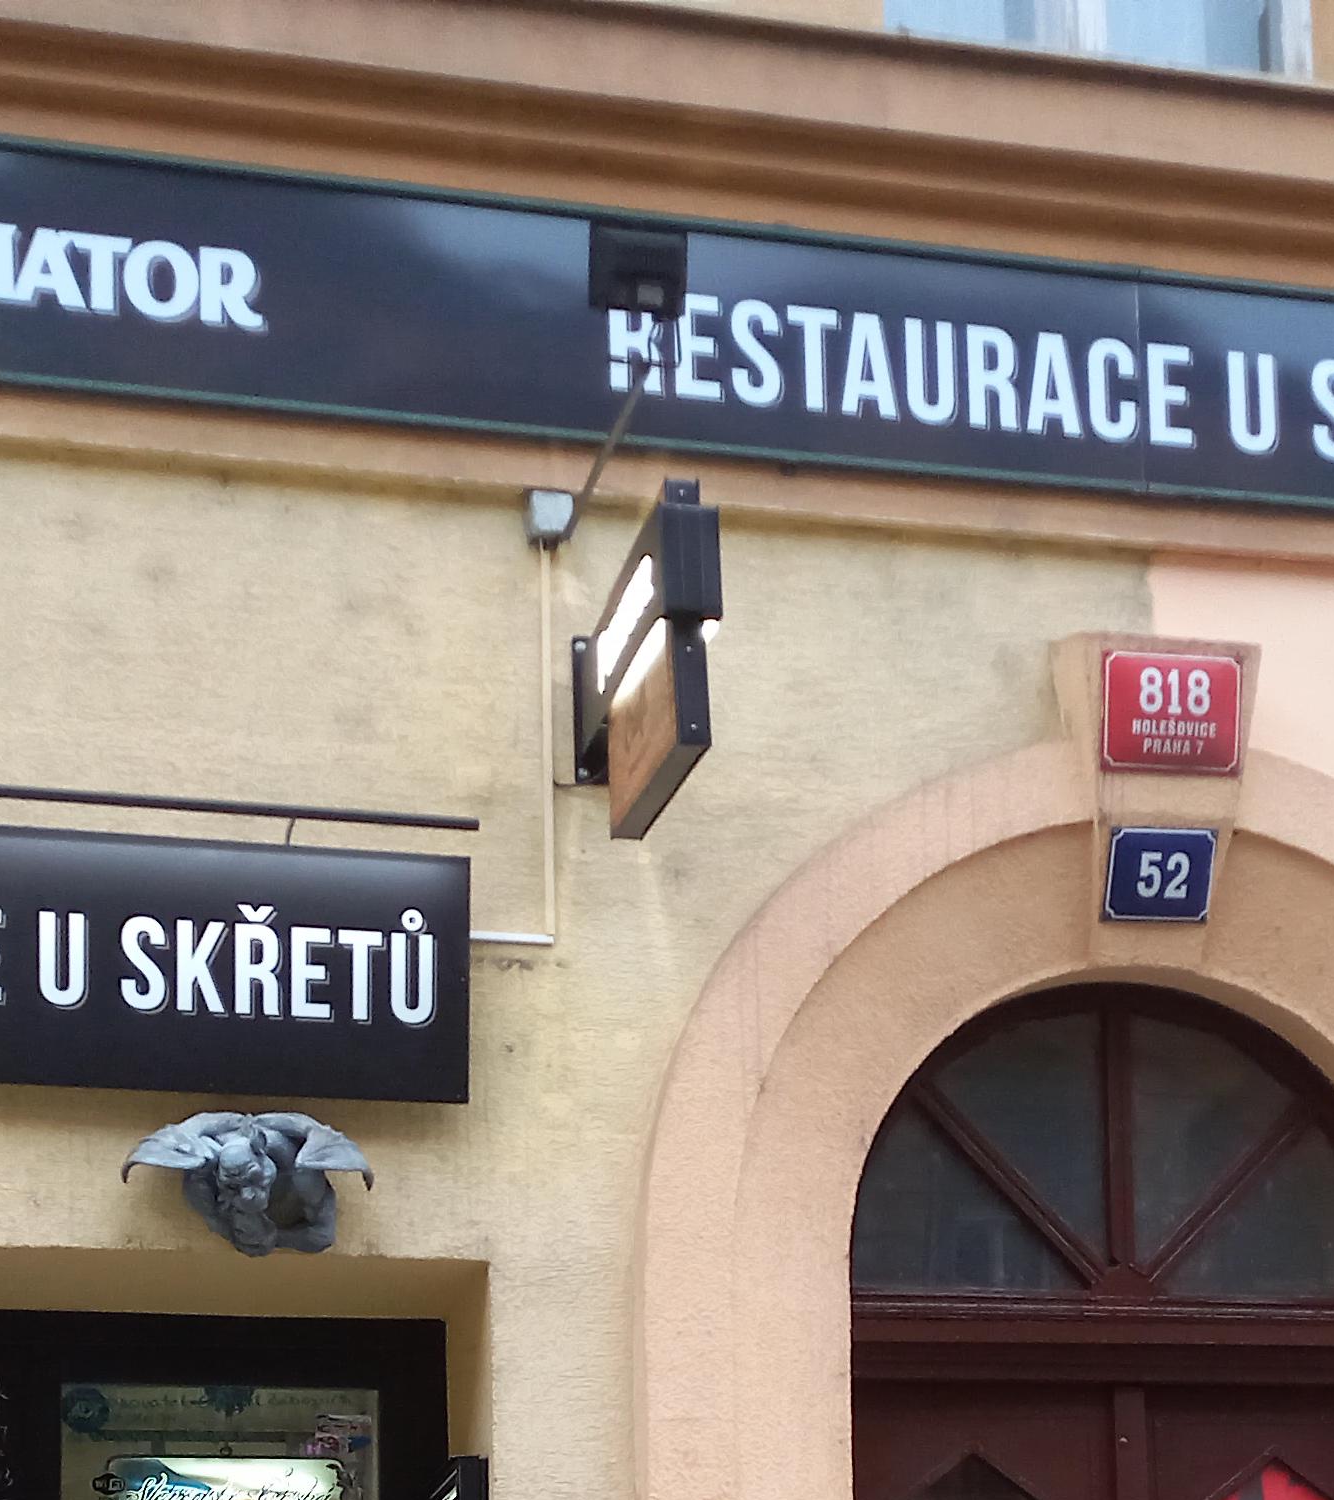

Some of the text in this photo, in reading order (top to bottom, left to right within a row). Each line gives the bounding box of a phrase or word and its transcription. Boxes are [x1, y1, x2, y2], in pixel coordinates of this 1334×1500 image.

[608, 293, 1197, 452] RESTAURACE
[1227, 348, 1281, 455] U
[1139, 666, 1211, 716] 818
[1132, 717, 1217, 738] HOLEŠOVICE
[1142, 737, 1204, 755] PRAHA 7
[1136, 850, 1190, 899] 52
[39, 909, 90, 1010] U
[119, 900, 438, 1029] SKŘETŮ
